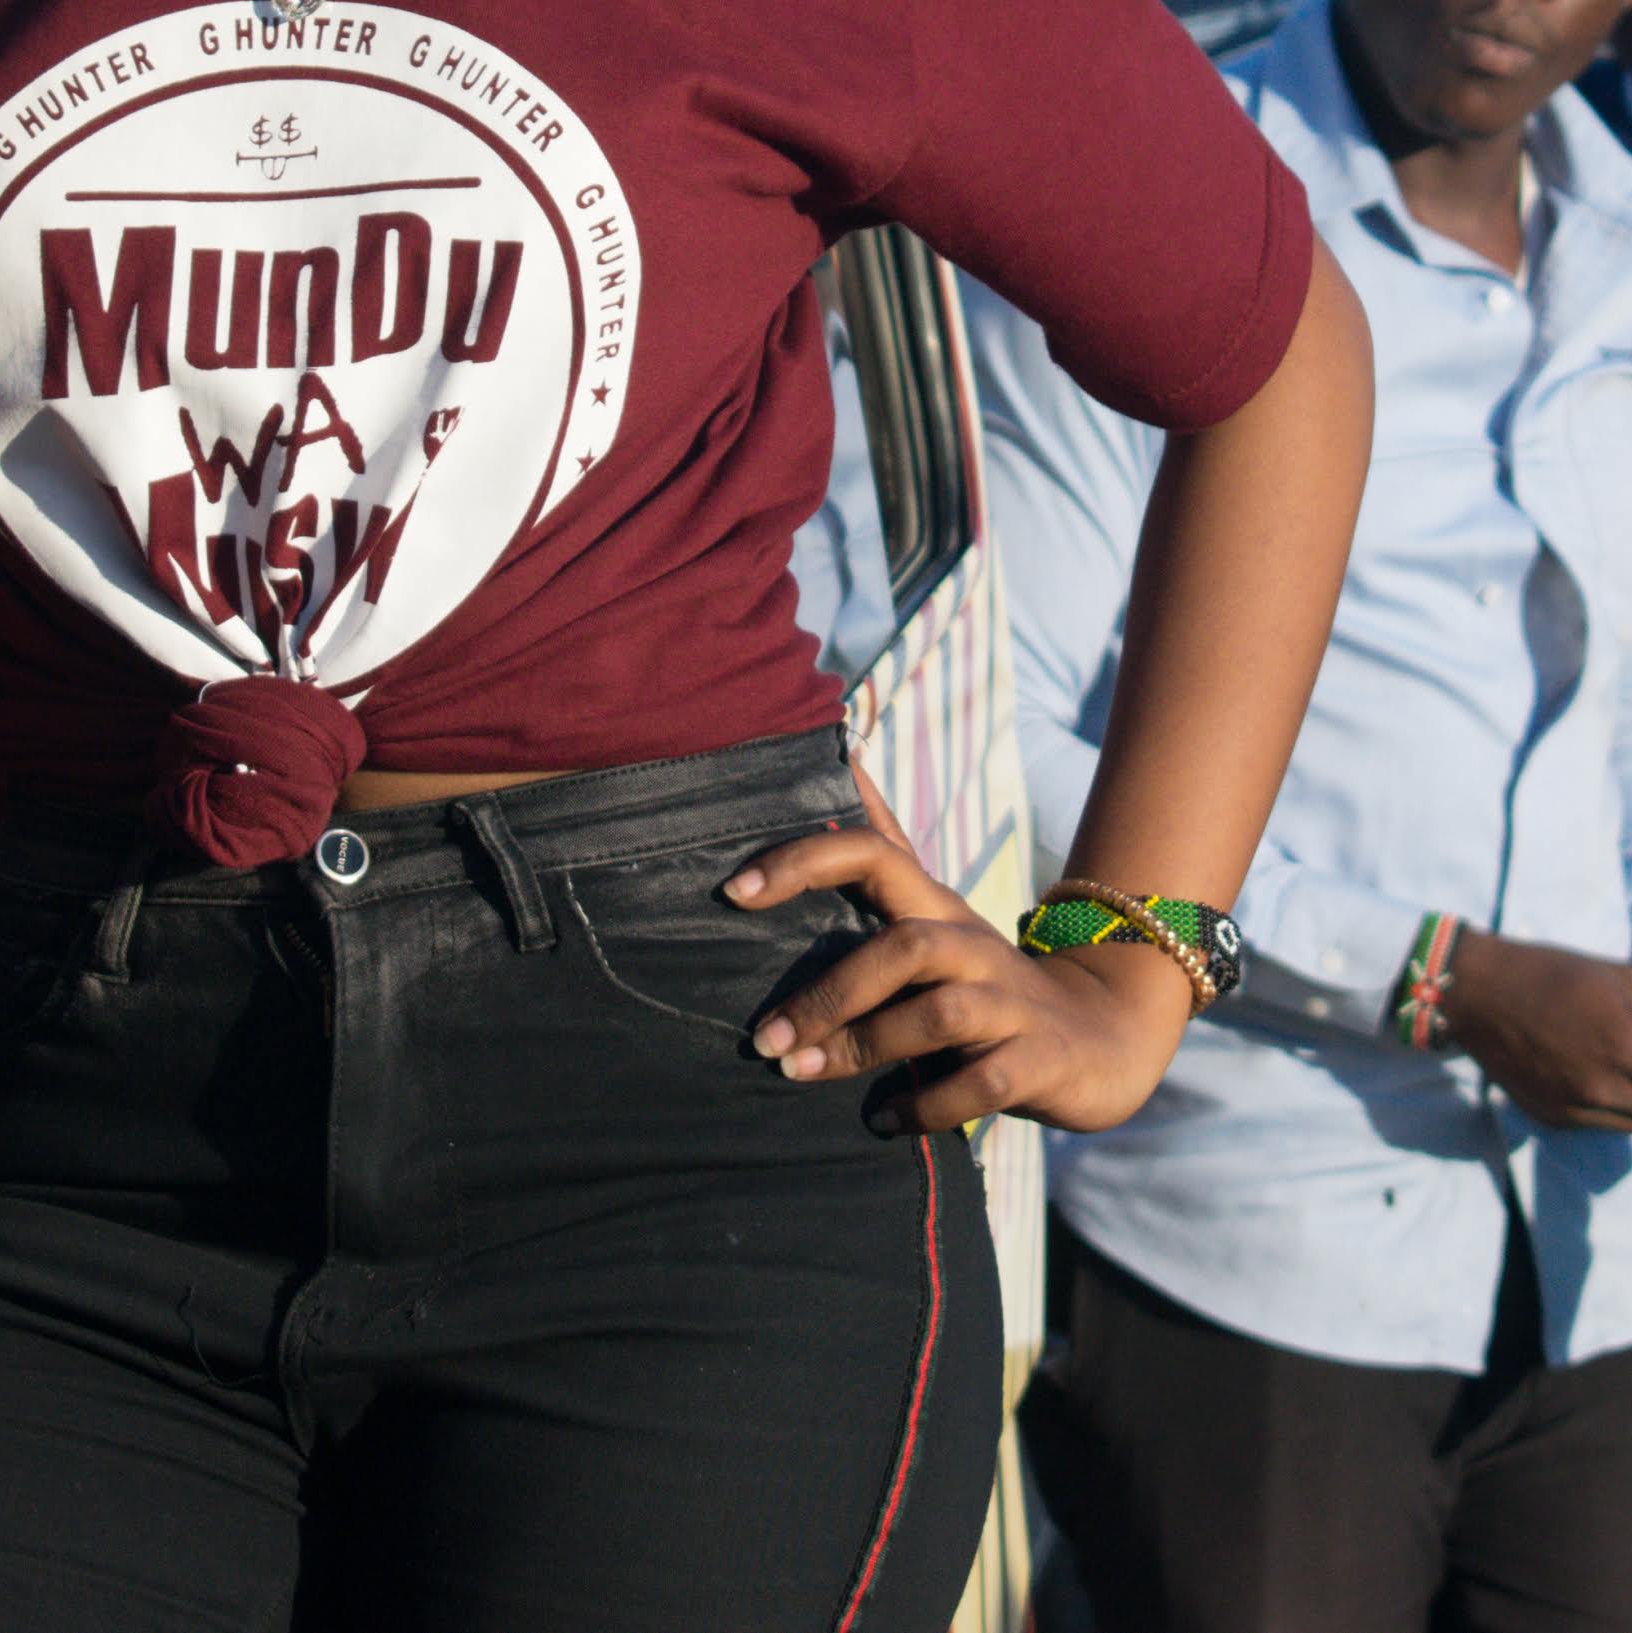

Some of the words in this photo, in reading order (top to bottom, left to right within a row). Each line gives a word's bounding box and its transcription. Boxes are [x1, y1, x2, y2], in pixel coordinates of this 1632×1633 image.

[15, 41, 157, 140] HUNTER
[199, 21, 220, 56] G
[235, 16, 378, 56] HUNTER
[409, 33, 432, 68] G
[436, 44, 564, 153] HUNTER
[575, 182, 606, 210] G
[588, 214, 627, 363] HUNTER
[178, 370, 366, 507] WA
